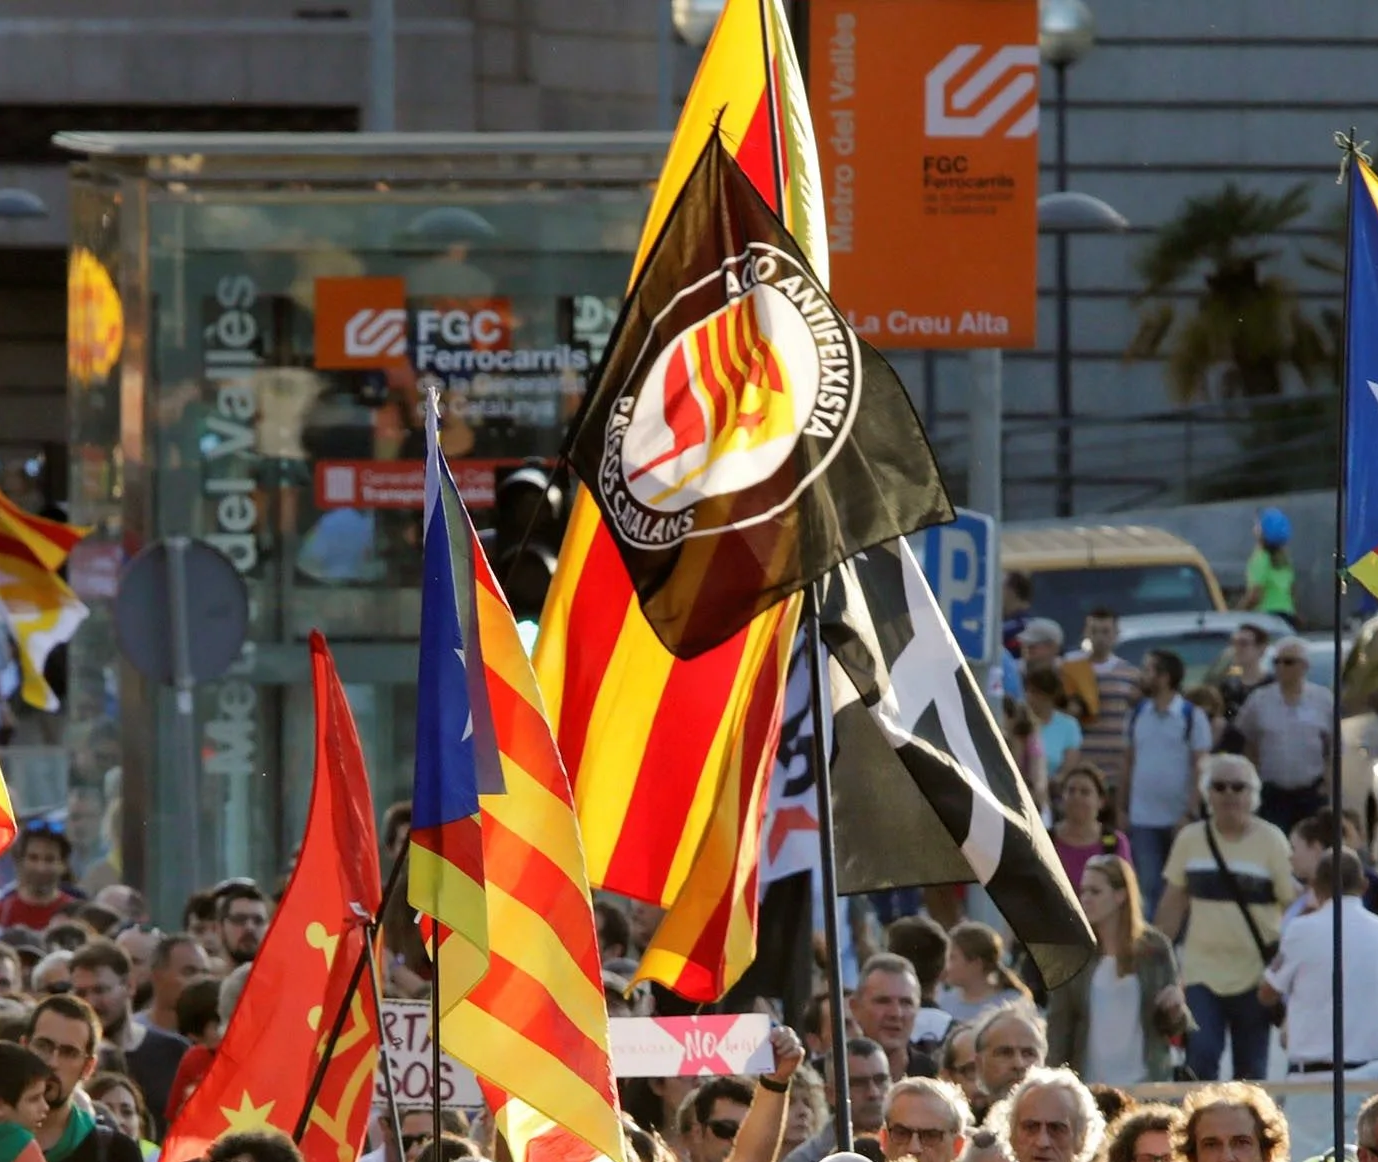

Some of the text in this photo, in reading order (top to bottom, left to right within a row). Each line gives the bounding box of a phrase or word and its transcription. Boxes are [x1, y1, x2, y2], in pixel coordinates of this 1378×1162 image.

[830, 13, 856, 253] Metro del Vallès
[923, 155, 967, 173] FGC
[417, 309, 502, 343] FGC
[848, 311, 1009, 335] La Creu Alta
[205, 276, 258, 457] Vallès
[417, 346, 589, 371] Ferrocarrils
[775, 274, 849, 439] ANTIFEIXISTA
[938, 528, 976, 622] P
[683, 1029, 718, 1061] NO
